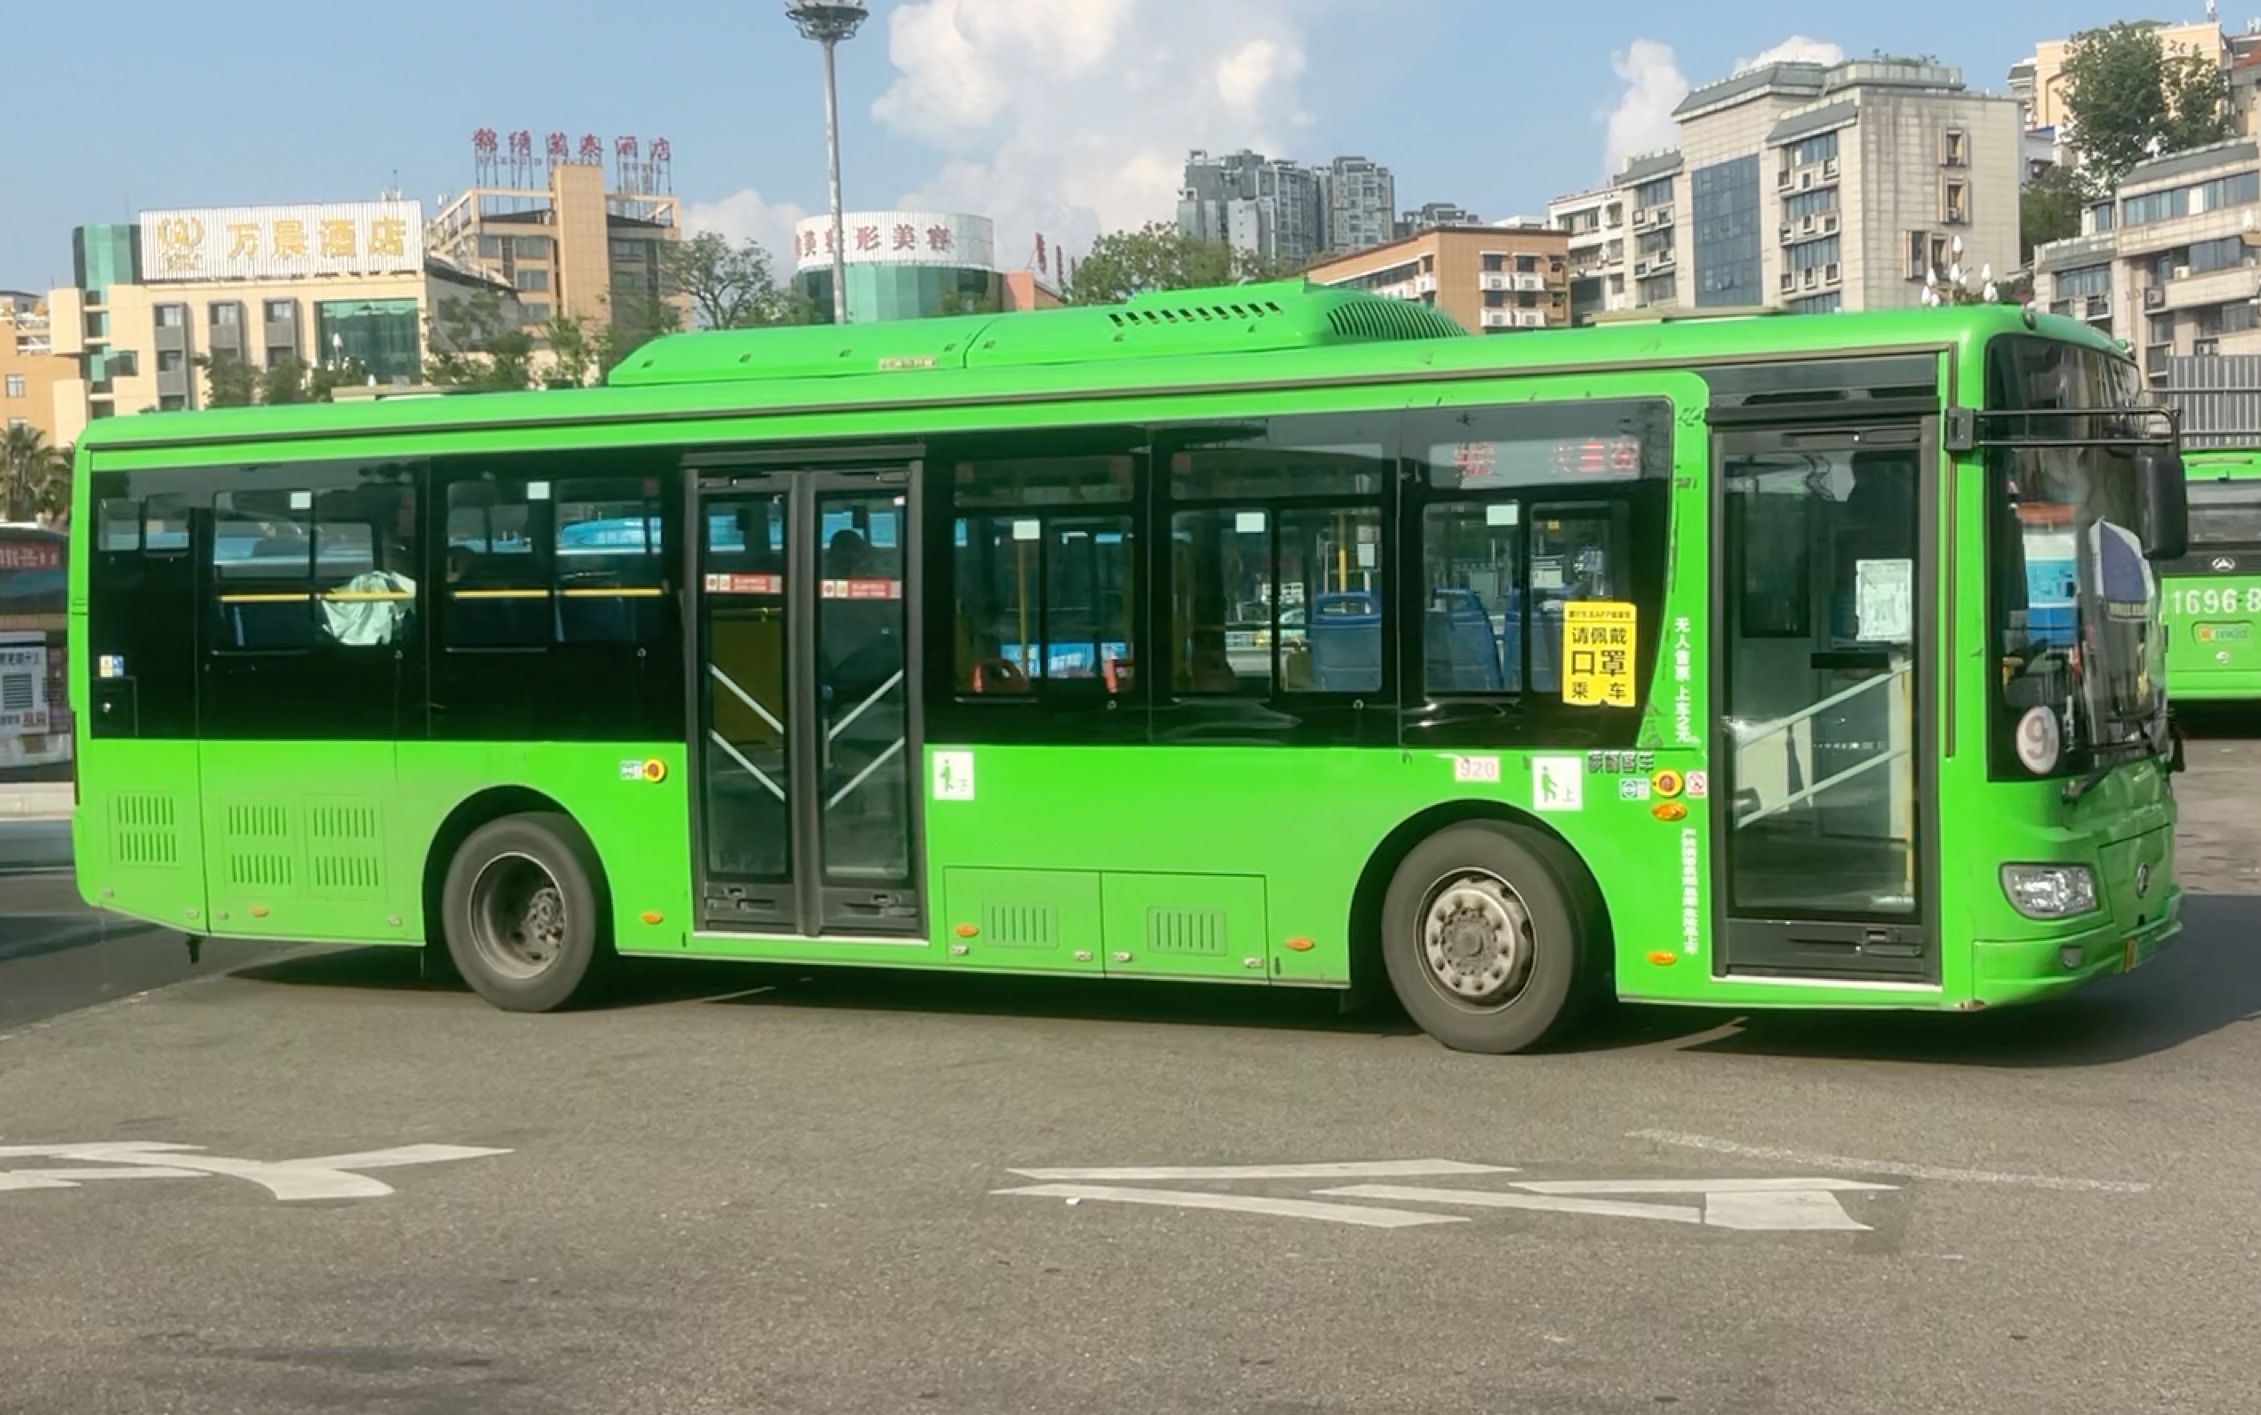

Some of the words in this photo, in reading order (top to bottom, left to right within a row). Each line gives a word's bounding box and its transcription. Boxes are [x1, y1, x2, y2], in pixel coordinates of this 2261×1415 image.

[1572, 626, 1628, 645] 请佩戴
[1571, 649, 1627, 677] 口罩
[1459, 760, 1496, 779] 920
